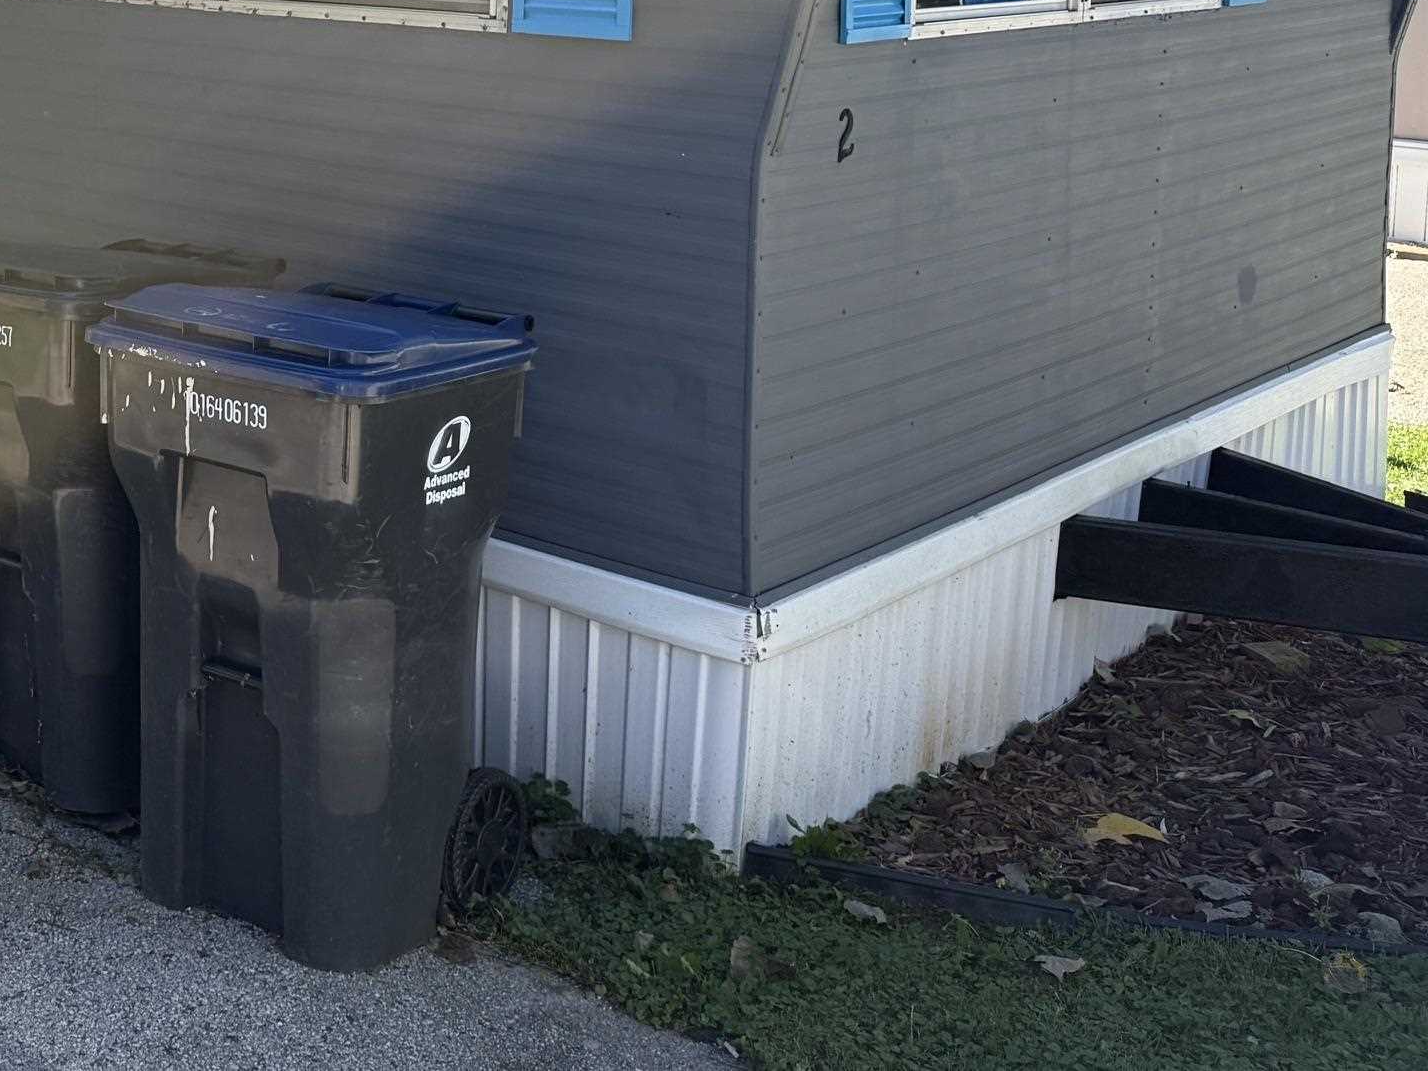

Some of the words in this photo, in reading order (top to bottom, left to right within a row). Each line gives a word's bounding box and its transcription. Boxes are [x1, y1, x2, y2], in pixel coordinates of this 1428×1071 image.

[838, 108, 855, 163] 2
[423, 465, 471, 490] Advanced
[425, 481, 466, 505] Disposal
